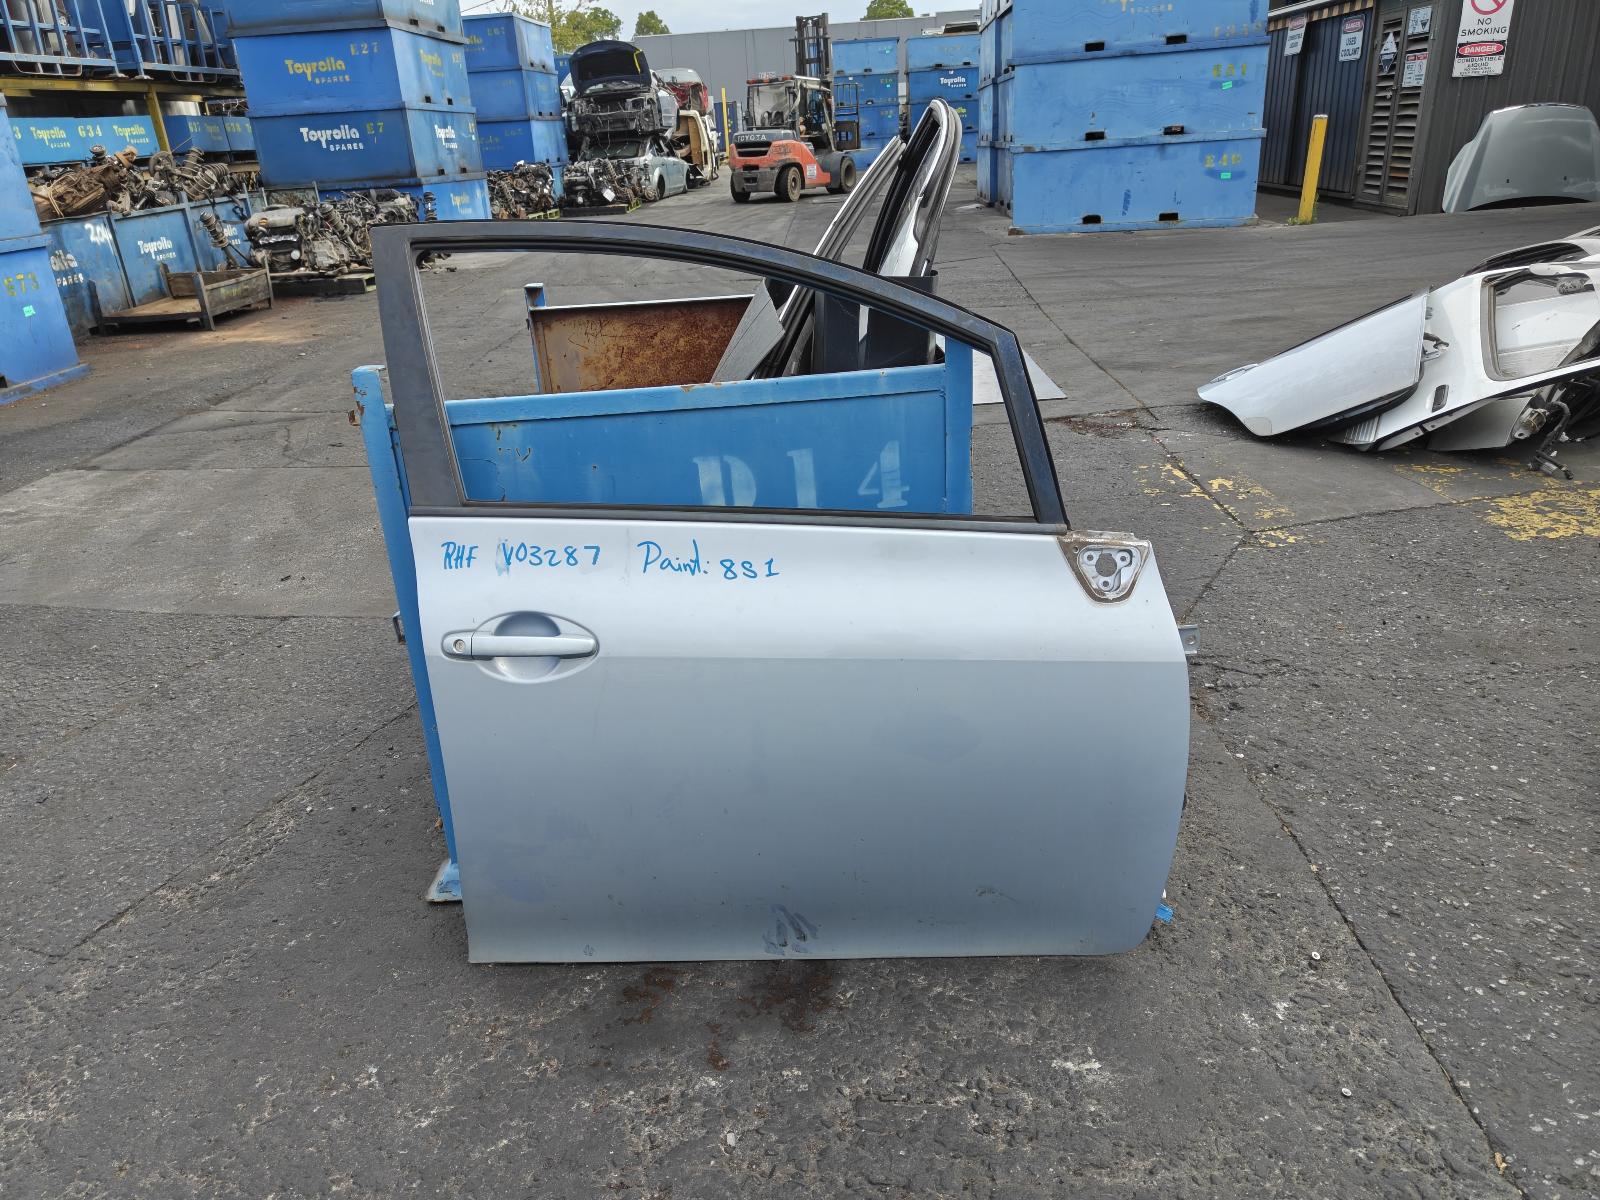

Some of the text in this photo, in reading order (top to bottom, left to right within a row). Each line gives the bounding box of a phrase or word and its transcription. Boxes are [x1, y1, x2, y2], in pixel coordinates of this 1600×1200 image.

[1477, 17, 1492, 26] NO
[1460, 26, 1507, 37] SMOKING
[1464, 45, 1497, 54] DANGER
[284, 56, 346, 82] Toyrolla
[315, 74, 350, 85] SPARES
[299, 124, 360, 149] Toyrolla
[737, 133, 767, 142] TOYOTA
[330, 142, 364, 152] SPARES
[137, 236, 173, 260] Toyrolla
[56, 272, 85, 288] PARES
[441, 541, 479, 570] RHF
